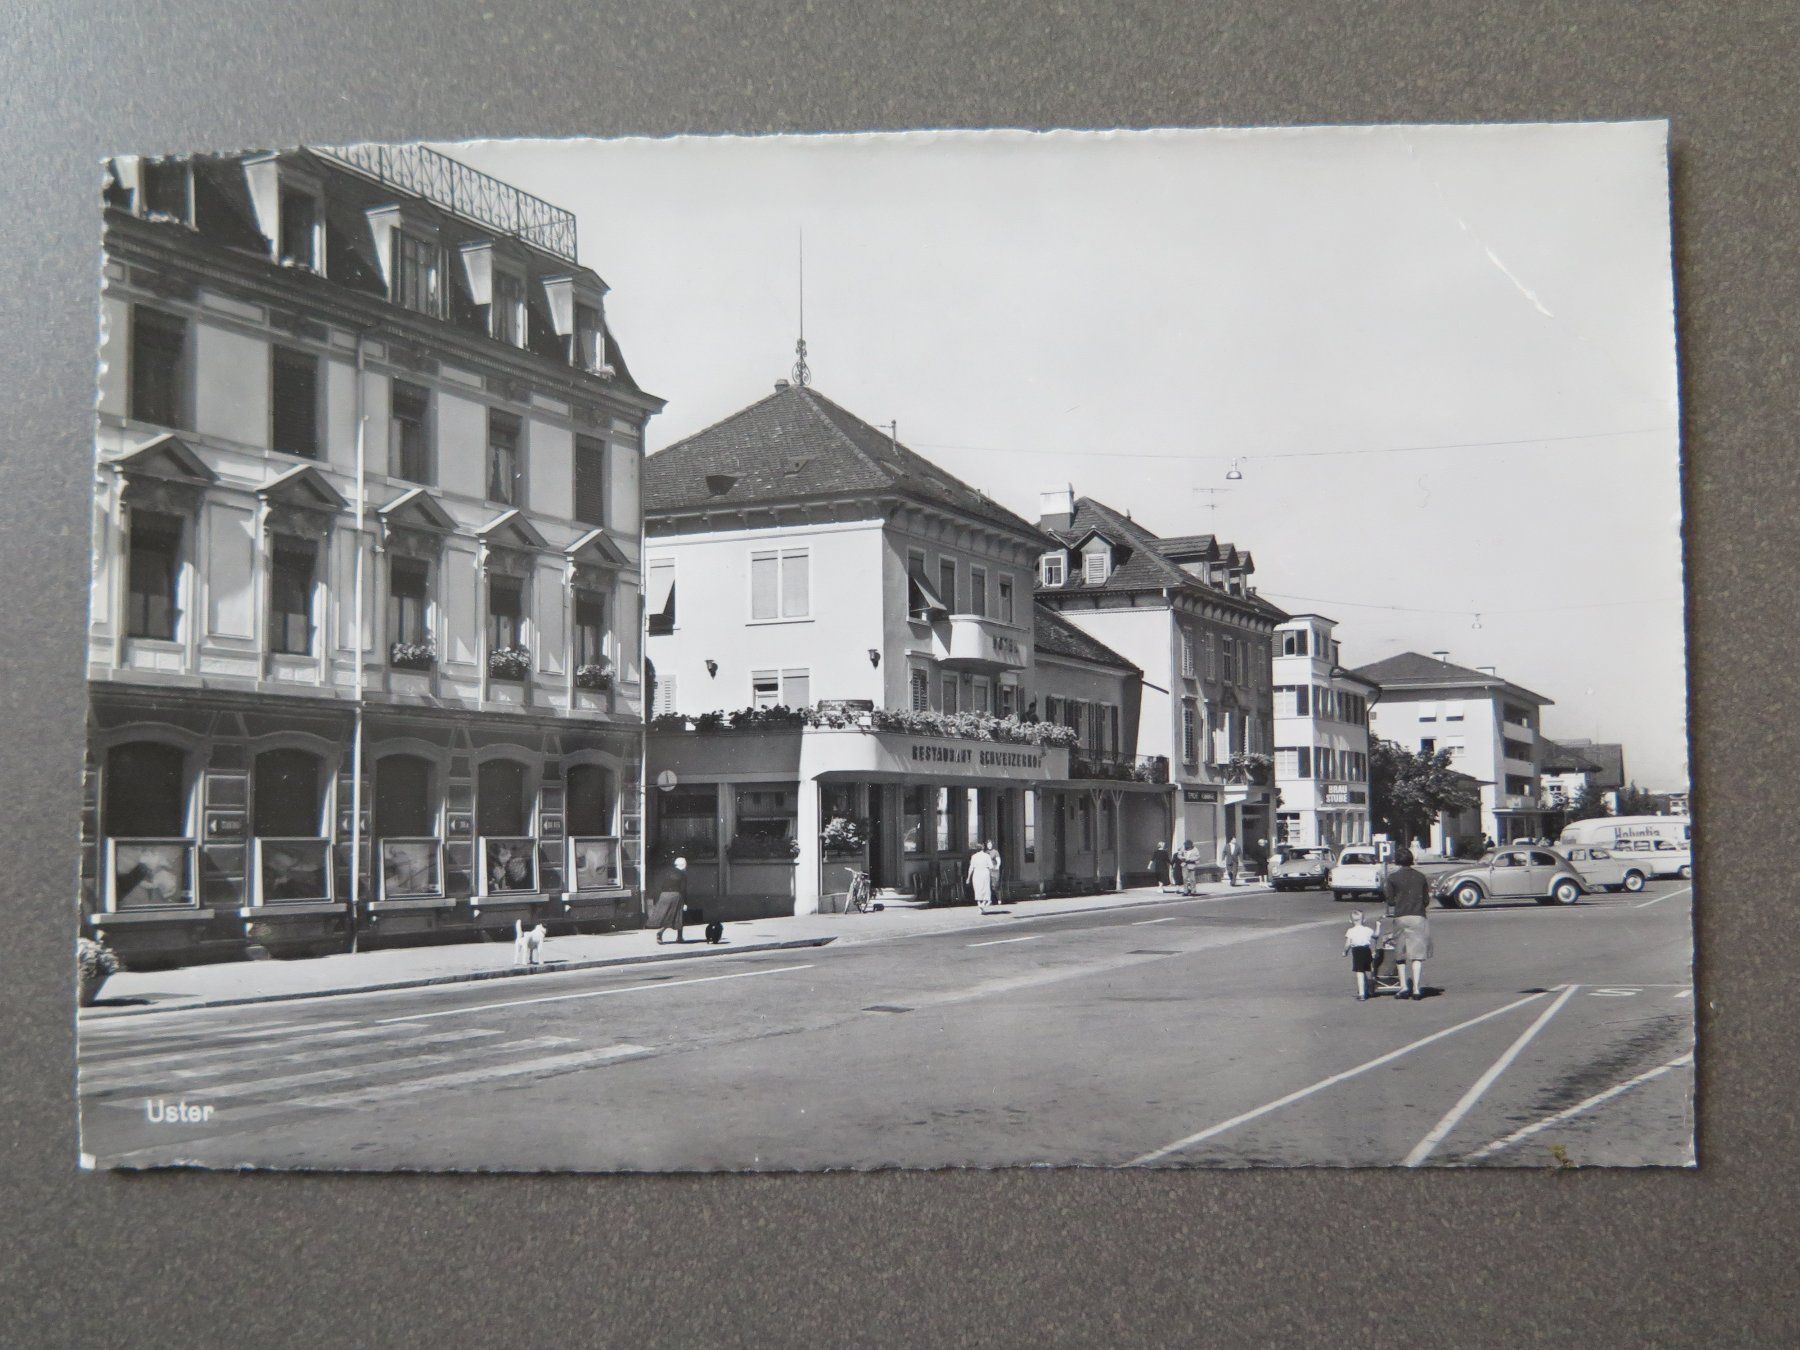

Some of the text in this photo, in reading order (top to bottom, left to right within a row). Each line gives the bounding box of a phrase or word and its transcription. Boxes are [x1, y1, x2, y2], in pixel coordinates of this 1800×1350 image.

[912, 745, 1042, 768] RESTAURANT SCHWEIZERHOF
[1328, 784, 1348, 793] BRAU
[1325, 794, 1348, 802] STUBE
[1379, 843, 1391, 862] P
